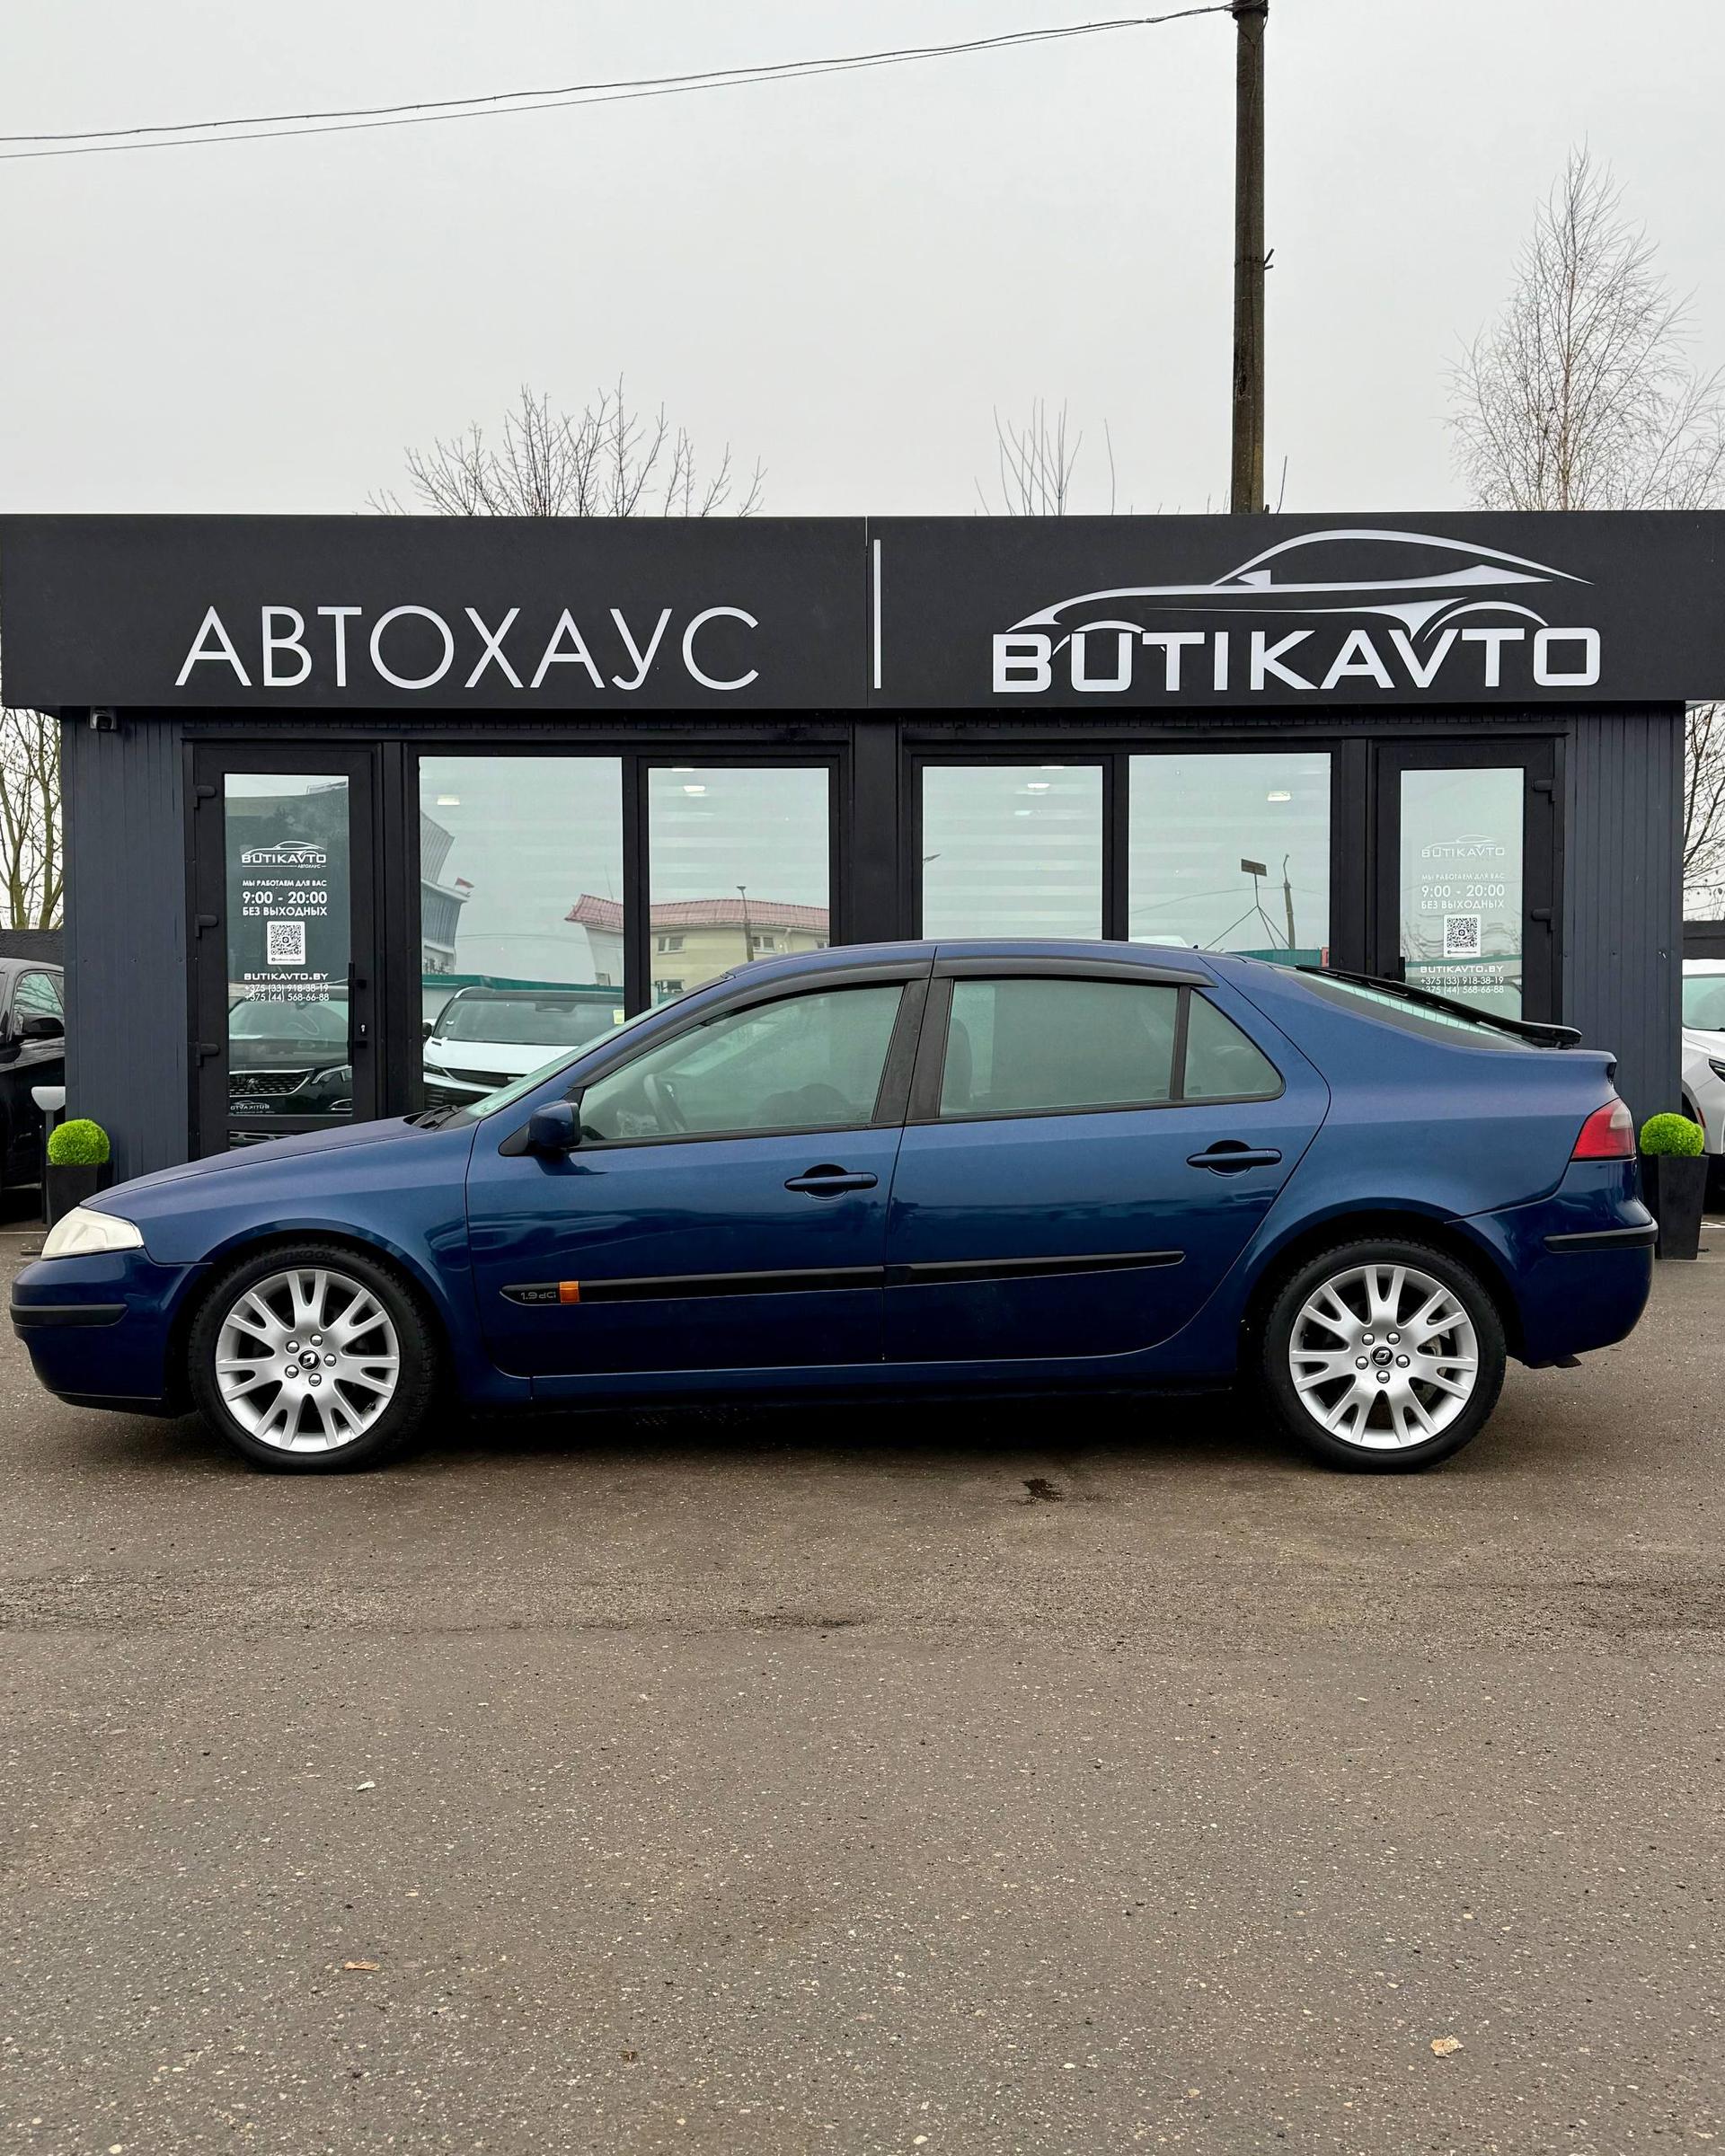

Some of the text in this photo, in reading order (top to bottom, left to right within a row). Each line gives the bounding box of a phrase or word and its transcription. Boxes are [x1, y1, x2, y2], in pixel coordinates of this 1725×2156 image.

[174, 605, 759, 690] АВТОХАУС
[992, 627, 1601, 693] BUTIKAVTO
[1421, 847, 1506, 857] BUTIKAVTO
[242, 853, 326, 863] BUTIKAVTO
[1421, 873, 1435, 881] МЫ
[295, 879, 310, 888] ДЛЯ
[1421, 885, 1451, 897] 9:00
[1466, 884, 1505, 897] 20:00
[243, 891, 273, 905] 9:00
[288, 891, 328, 905] 20:00
[1421, 899, 1505, 910] БЕЗ ВЫХОДНЫХ
[243, 906, 328, 916] БЕЗ ВЫХОДНЫХ
[1420, 965, 1505, 973] BUTIKAVTO.BY
[243, 973, 329, 981] BUTIKAVTO.BY
[1420, 976, 1504, 987] +375 (33) 918-38-19
[244, 984, 329, 994] +375 (33) 918-38-19
[1444, 985, 1460, 995] (44)
[1463, 985, 1505, 994] 568-66-88
[244, 993, 330, 1003] +375 (44) 568-66-88
